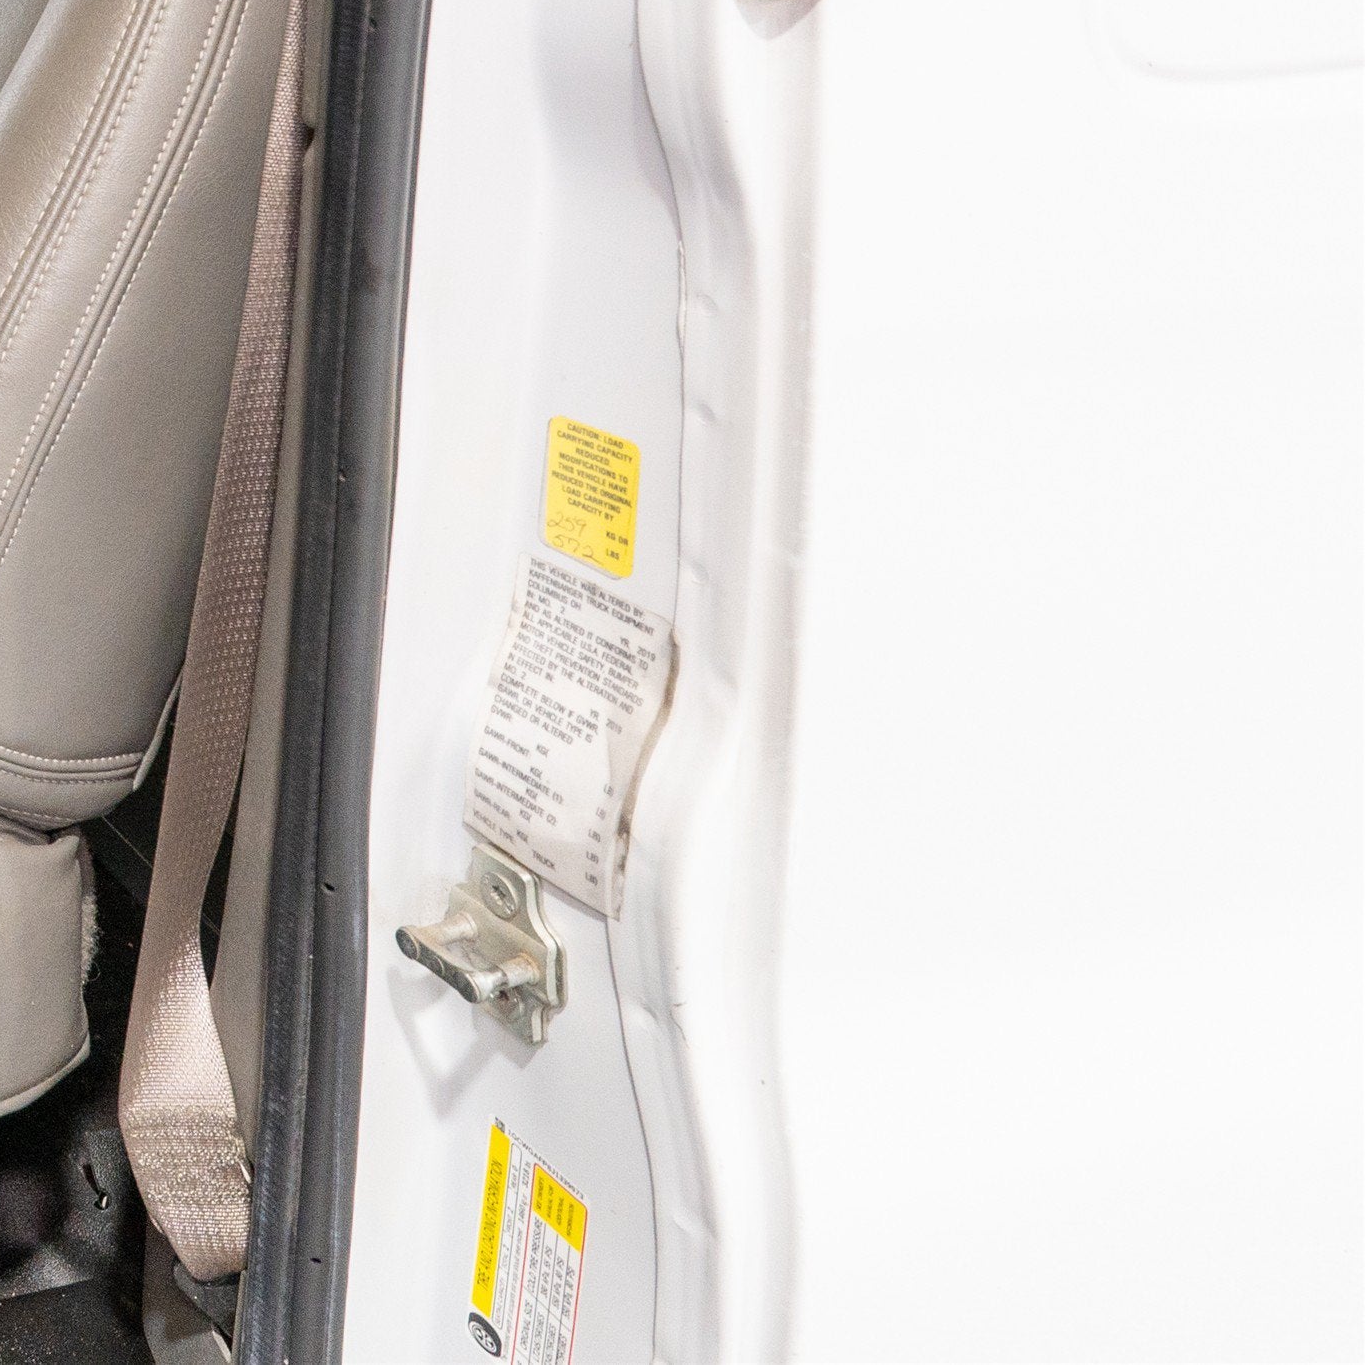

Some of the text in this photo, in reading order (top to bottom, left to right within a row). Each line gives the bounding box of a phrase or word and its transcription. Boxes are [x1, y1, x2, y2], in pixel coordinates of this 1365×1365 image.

[557, 430, 633, 463] CARRYING CAPACITY
[603, 436, 624, 449] LOAD
[558, 461, 628, 493] THIS VEHICLE HAVE
[559, 452, 628, 484] MODIFICATIONS TO
[551, 470, 633, 508] REDUCED THE ORIGINAL
[562, 484, 621, 514] LOAD CARRYING
[567, 497, 602, 516] CAPACITY
[547, 511, 628, 546] 259 KG OR
[527, 579, 582, 611] COLUMBUS OH
[528, 568, 655, 636] KAFFENBARGER TRUCK EQUIPMENT
[530, 557, 545, 571] THIS
[548, 564, 578, 586] VEHICLE
[580, 581, 596, 596] WAS
[597, 590, 631, 613] ALTERED
[560, 606, 565, 616] 2
[522, 611, 534, 622] ALL
[536, 619, 578, 644] APPLICABLE
[601, 652, 634, 675] FEDERAL
[524, 601, 649, 671] AND AS ALTERED IT CONFORMS TO
[636, 646, 656, 662] 2019
[507, 652, 515, 662] IN
[516, 656, 543, 676] EFFECT
[517, 632, 644, 707] AND THEFT PREVENTION STANDARDS
[520, 621, 545, 638] MOTOR
[546, 634, 575, 656] VEHICLE
[607, 667, 640, 690] BUMPER
[500, 672, 539, 698] COMPLETE
[540, 694, 566, 714] BELOW
[568, 709, 574, 717] IF
[512, 642, 634, 715] AFFECTED BY THE ALTERATION AND
[520, 671, 527, 681] 2
[494, 694, 573, 745] CHANGED OR ALTERED
[522, 697, 533, 708] OR
[535, 704, 564, 726] VEHICLE
[567, 721, 583, 738] TYPE
[584, 733, 593, 744] IS
[605, 718, 622, 735] 2019
[478, 747, 550, 797] GAWR-INTERMEDIATE
[474, 767, 545, 818] GAWR-INTERMEDIATE
[473, 808, 497, 833] VEHICLE
[532, 850, 556, 872] TRUCK
[477, 1156, 502, 1290] TIRE AND LOADING INFORMATION
[528, 1217, 541, 1292] COLD TIRE PRESSURE
[521, 1300, 532, 1350] ORIGINAL SIZE
